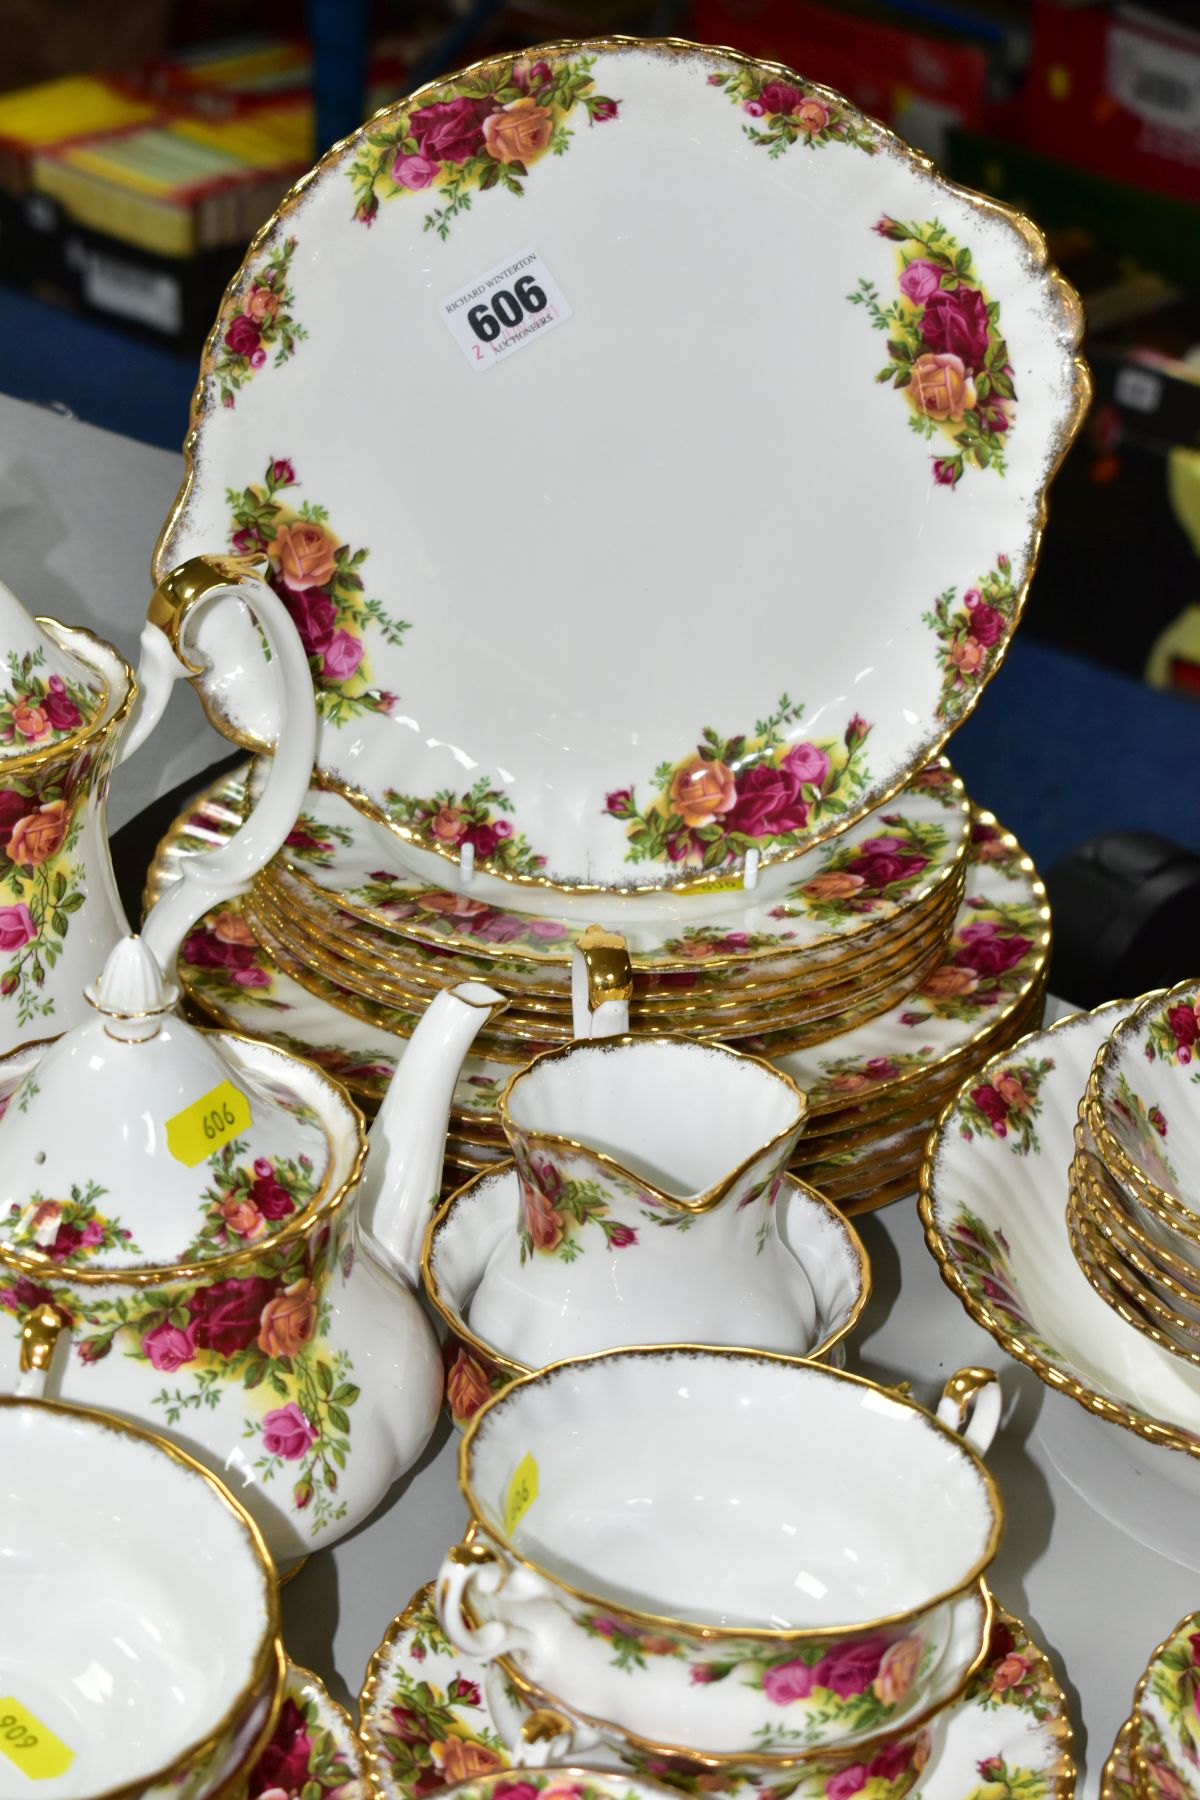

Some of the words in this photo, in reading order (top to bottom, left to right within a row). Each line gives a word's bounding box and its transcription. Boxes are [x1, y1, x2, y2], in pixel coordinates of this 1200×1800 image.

[446, 285, 486, 314] RICHARD
[485, 253, 537, 288] WINTERTON
[467, 275, 548, 343] 606
[493, 313, 554, 355] AUCTIONEERS
[203, 1101, 235, 1140] 606
